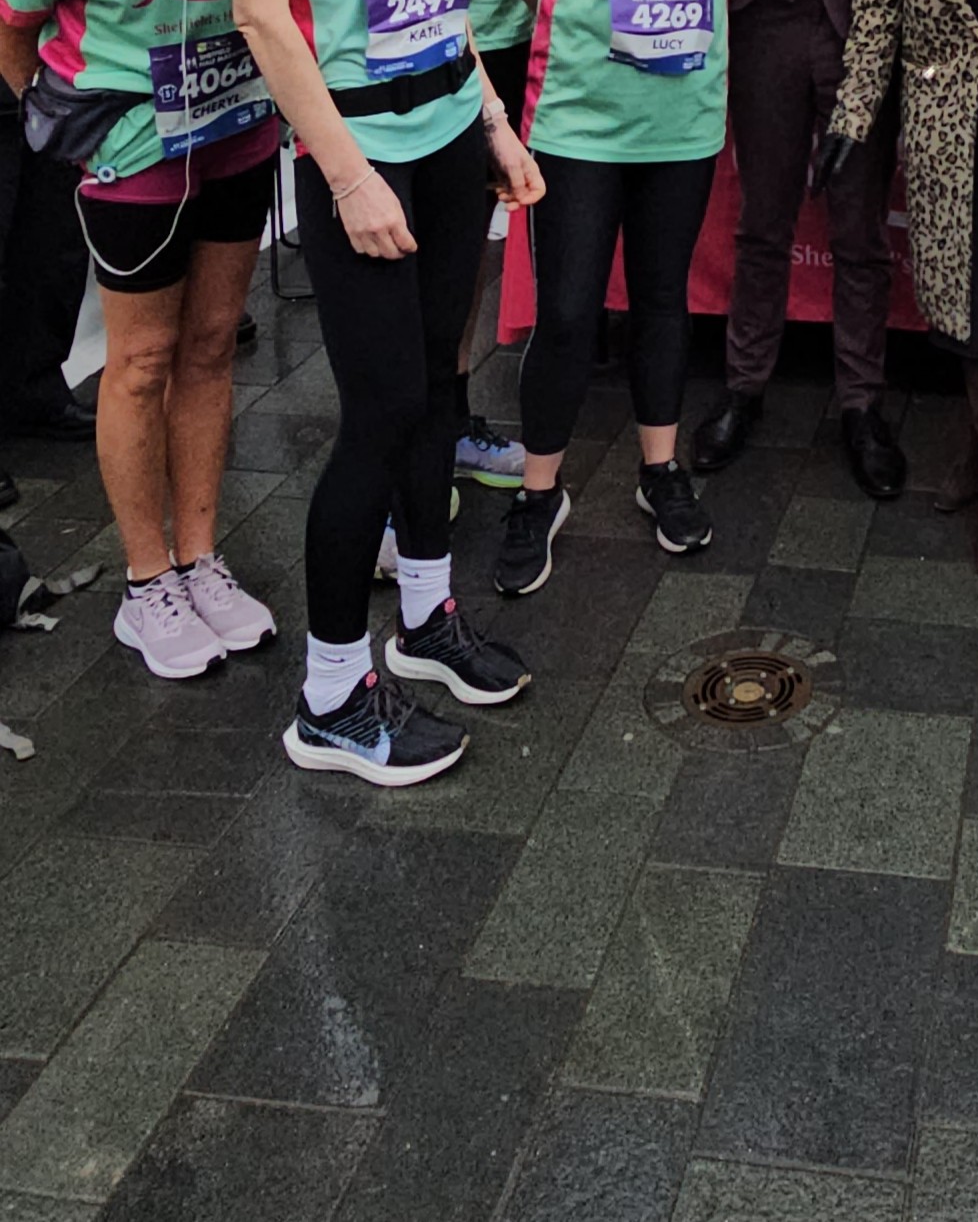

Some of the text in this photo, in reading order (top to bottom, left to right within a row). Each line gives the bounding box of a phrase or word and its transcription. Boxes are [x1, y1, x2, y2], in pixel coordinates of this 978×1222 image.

[153, 14, 221, 36] Shefield's
[631, 2, 704, 30] 4269
[409, 23, 444, 42] KATIE
[652, 38, 685, 51] LUCY
[178, 55, 254, 99] 4064
[191, 94, 241, 119] CHERYL
